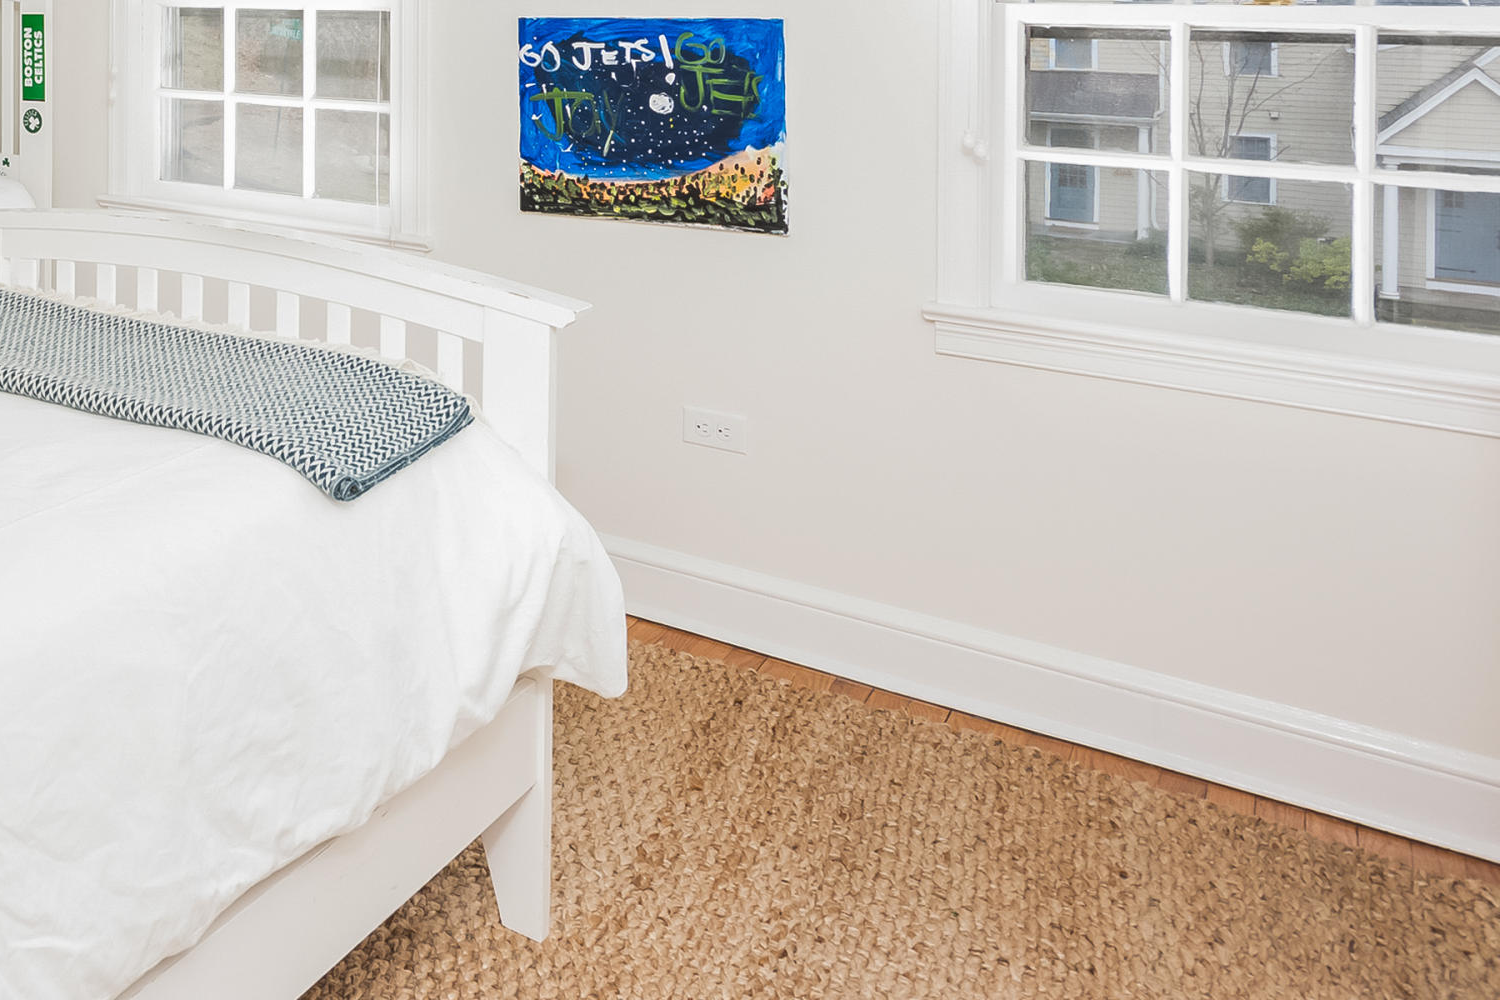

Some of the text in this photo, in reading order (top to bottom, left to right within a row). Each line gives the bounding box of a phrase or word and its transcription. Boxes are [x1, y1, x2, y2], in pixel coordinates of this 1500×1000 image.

[23, 27, 33, 87] BOSTON
[33, 30, 43, 85] CELTICS
[519, 41, 561, 72] GO
